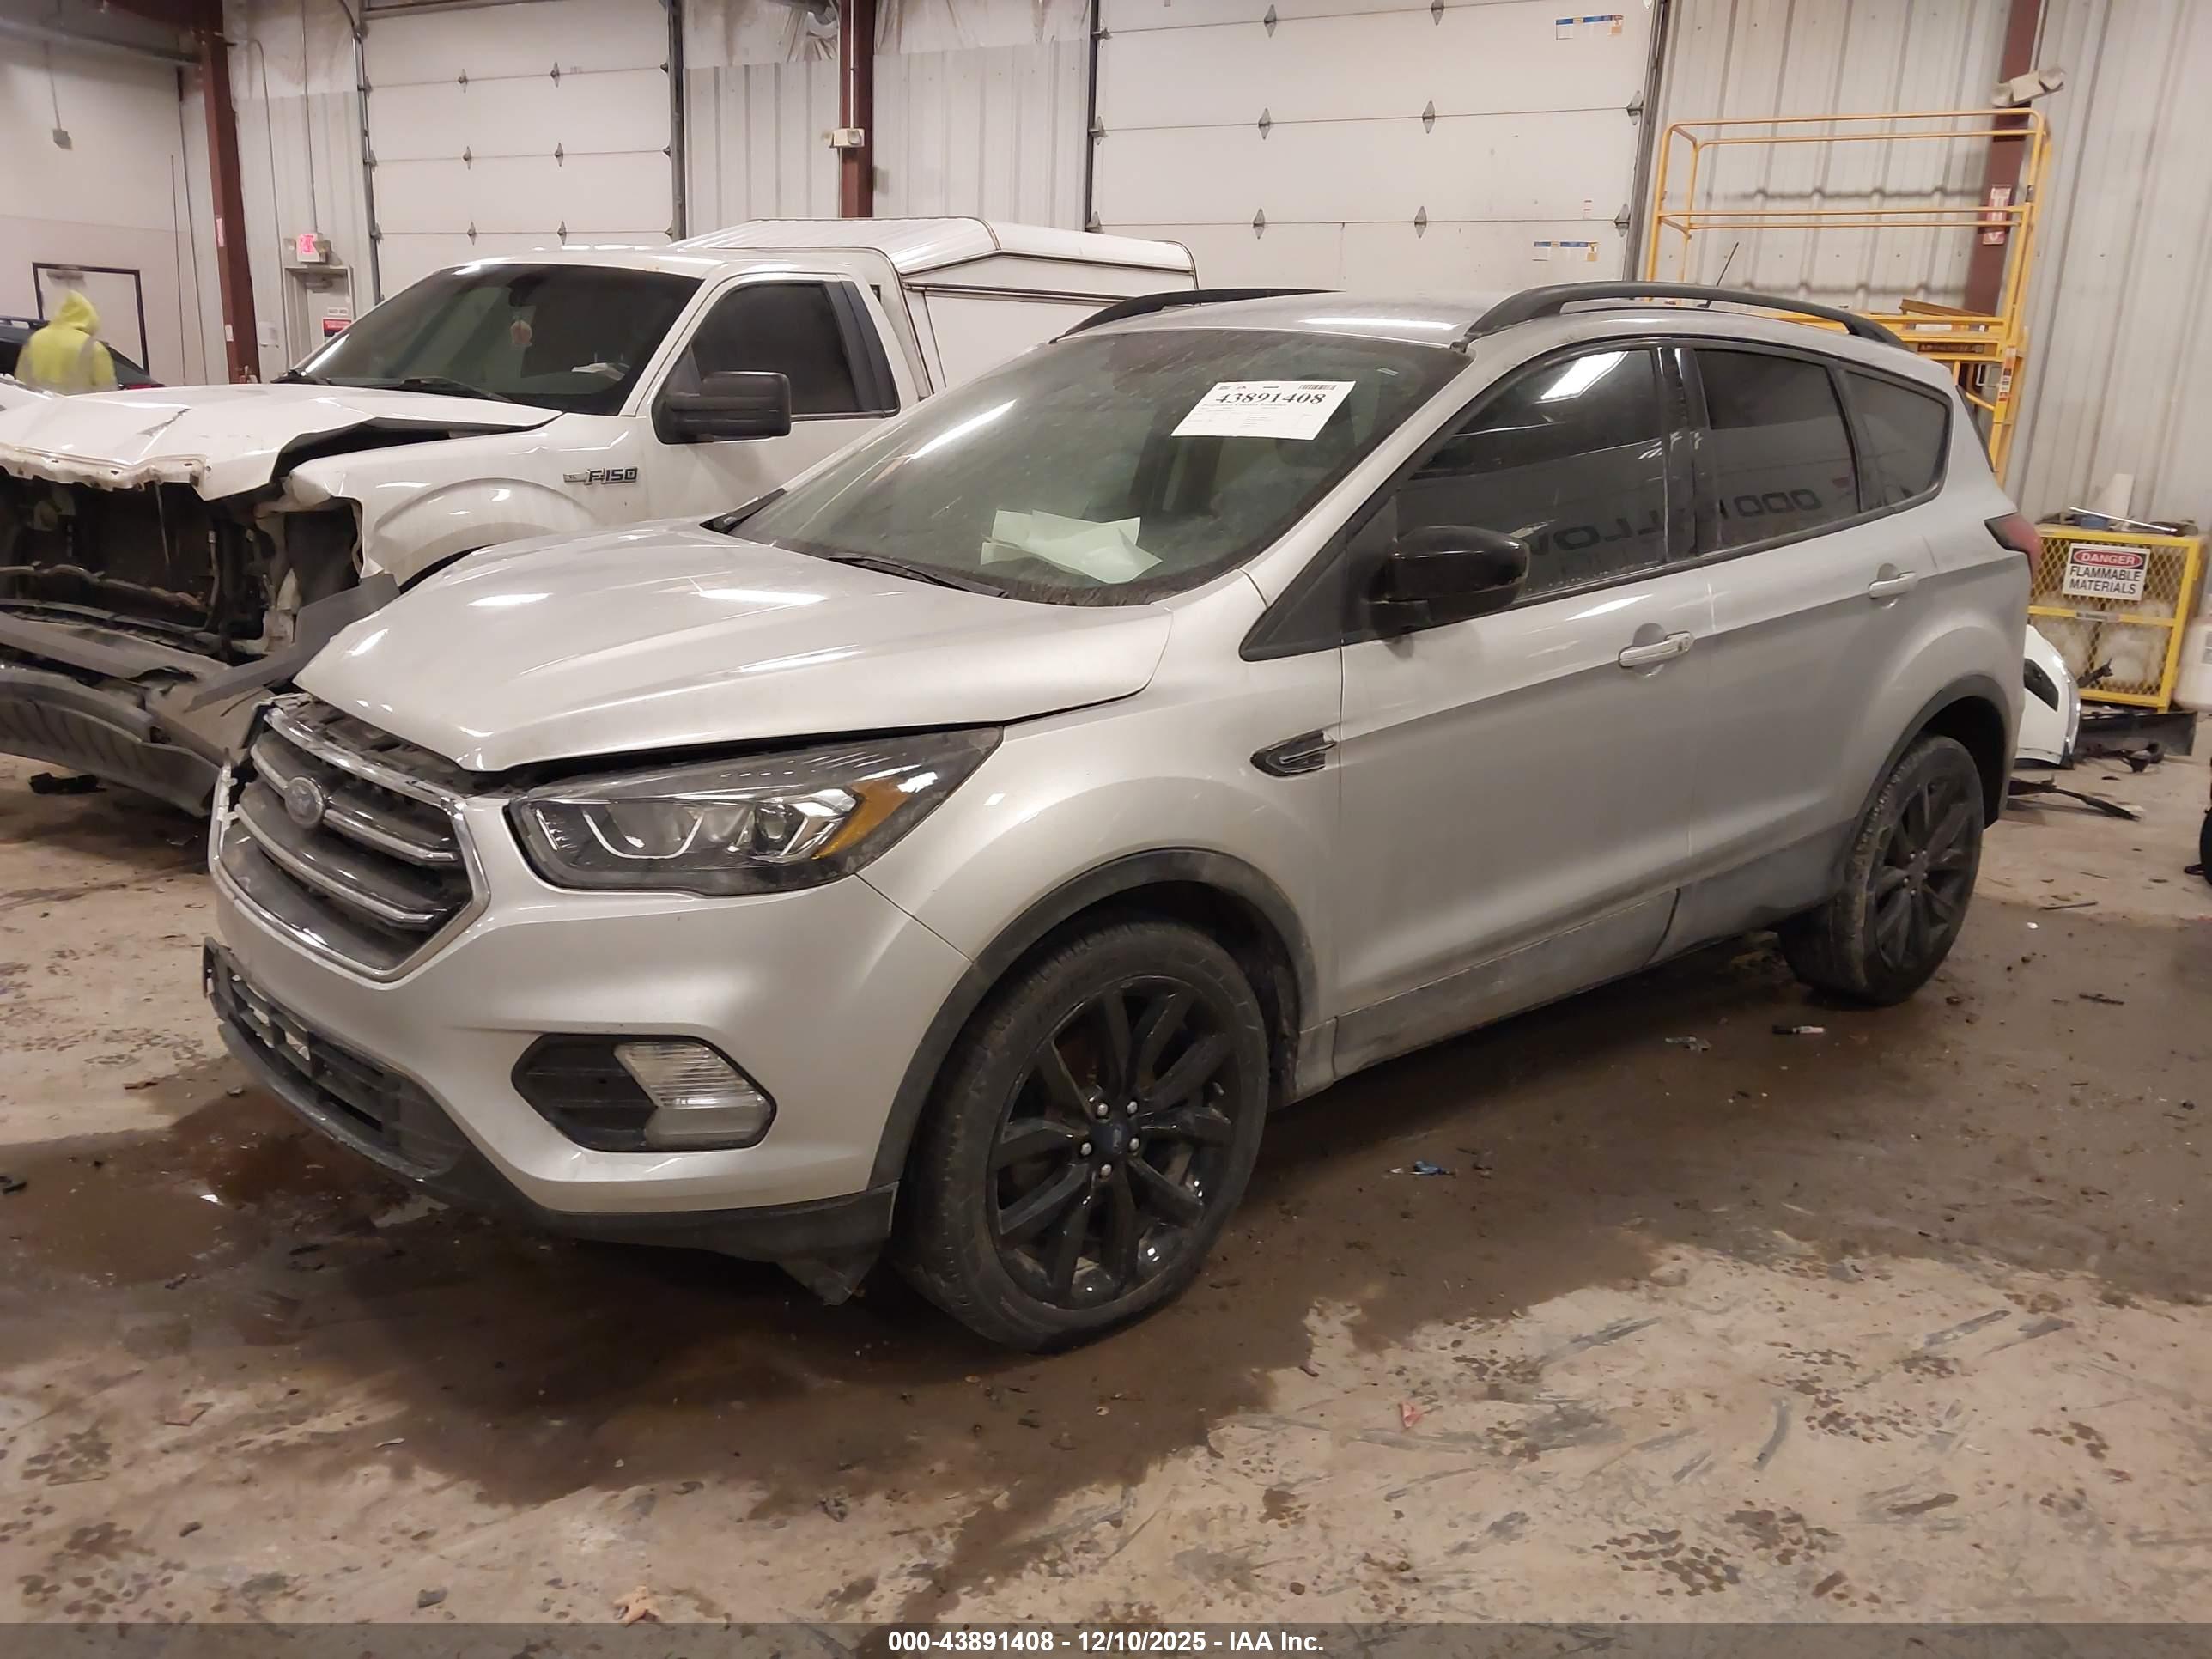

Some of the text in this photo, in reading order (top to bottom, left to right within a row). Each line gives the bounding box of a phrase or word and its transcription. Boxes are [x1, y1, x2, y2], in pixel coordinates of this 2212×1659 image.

[1215, 392, 1327, 404] 43891408
[2081, 553, 2136, 566] DANGER
[2069, 565, 2142, 582] FLAMMABLE
[2069, 578, 2136, 595] MATERIALS
